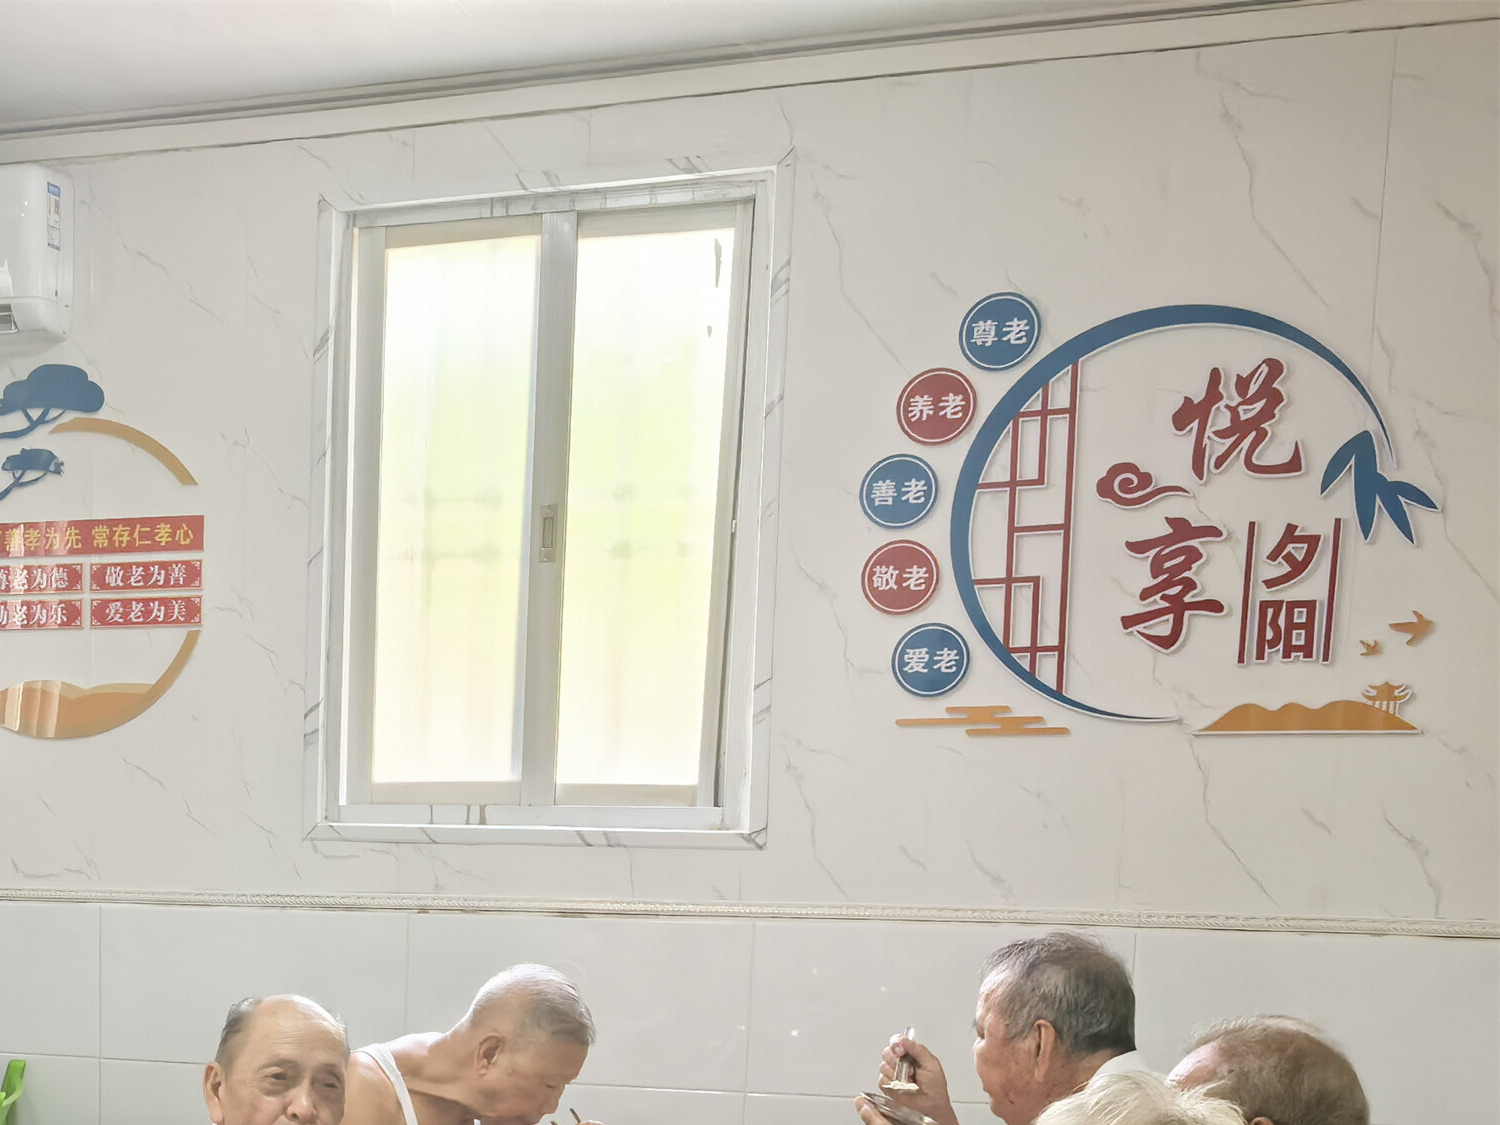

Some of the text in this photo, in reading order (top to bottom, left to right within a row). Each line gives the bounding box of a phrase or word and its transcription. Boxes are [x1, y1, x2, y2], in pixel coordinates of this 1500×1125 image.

[970, 316, 1032, 348] 尊老
[907, 392, 966, 422] 养老
[1171, 357, 1303, 482] 悦
[870, 478, 928, 506] 善老
[91, 522, 194, 548] 常存仁孝心
[105, 563, 187, 588] 敬老为善
[871, 564, 930, 593] 敬老
[1120, 516, 1226, 651] 享
[1255, 523, 1322, 661] 夕阳
[105, 600, 187, 624] 爱老为美
[902, 646, 960, 675] 爱老
